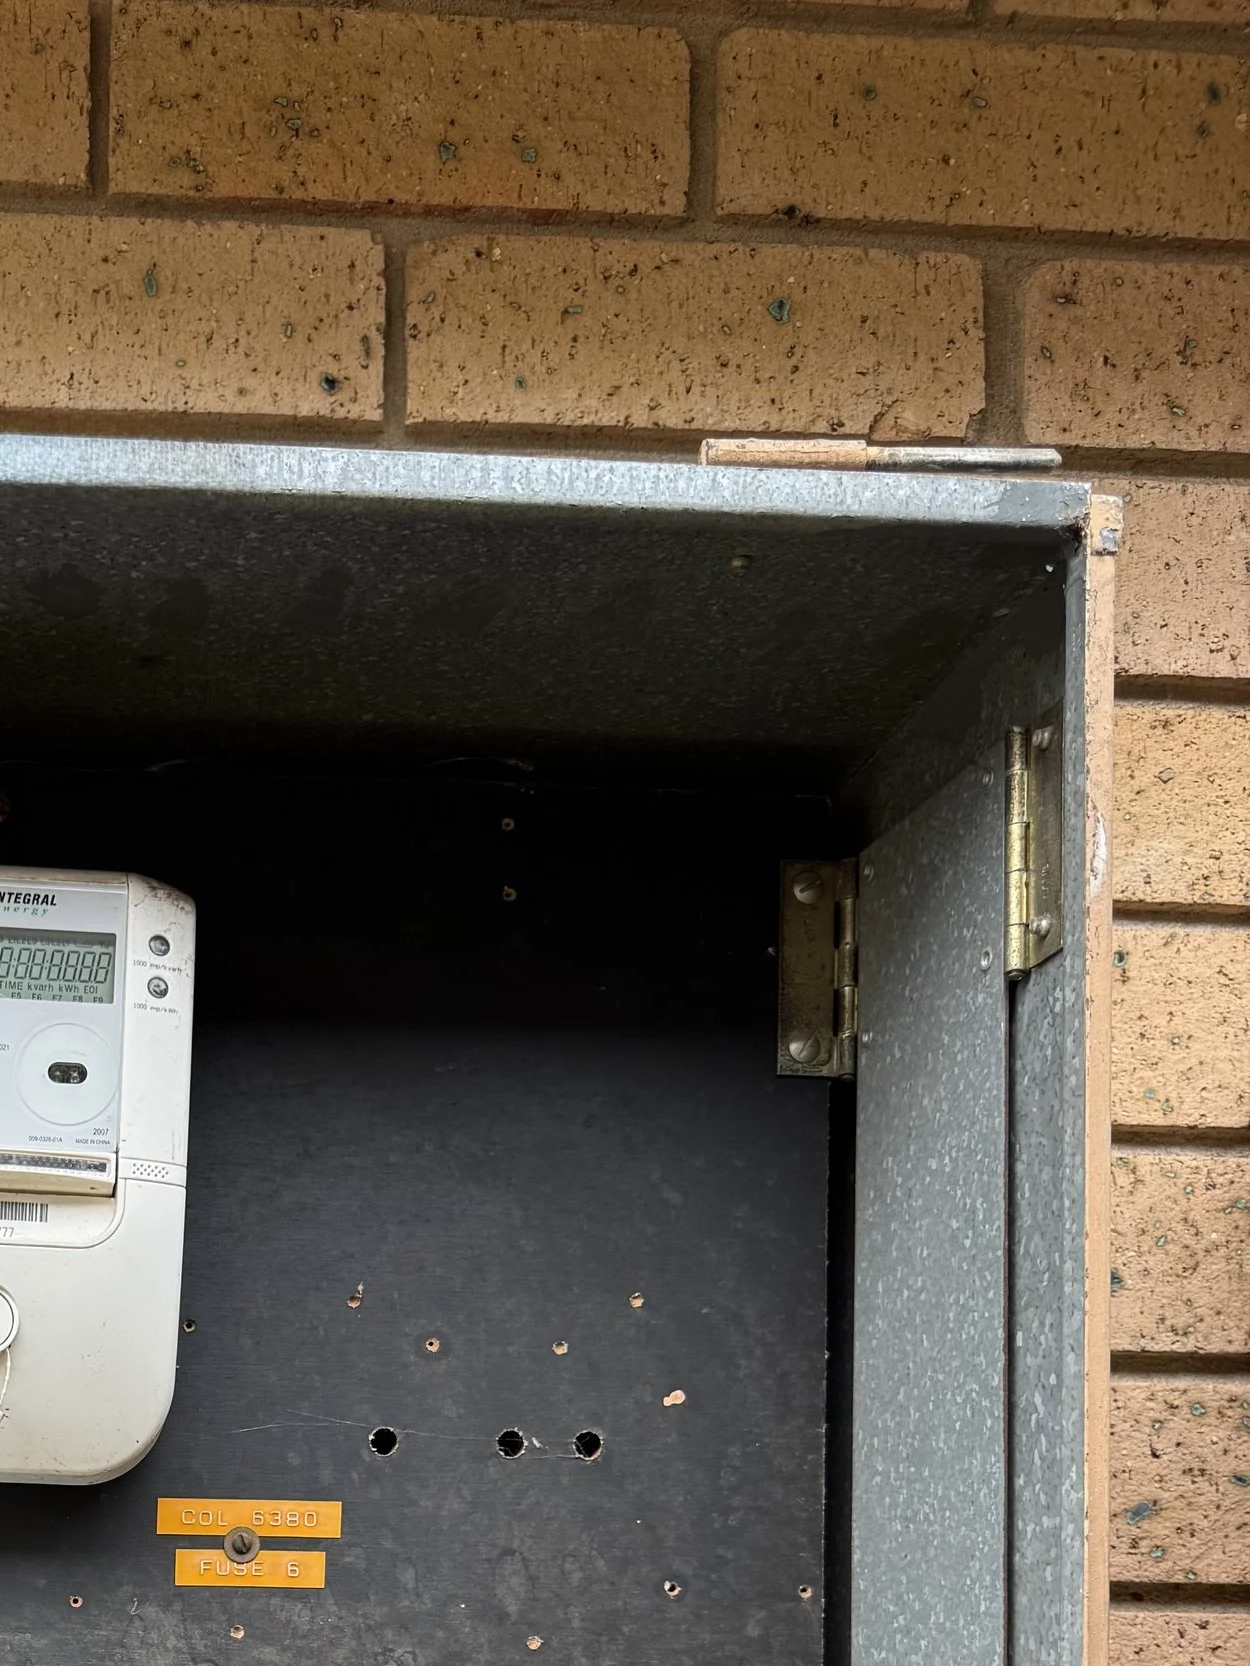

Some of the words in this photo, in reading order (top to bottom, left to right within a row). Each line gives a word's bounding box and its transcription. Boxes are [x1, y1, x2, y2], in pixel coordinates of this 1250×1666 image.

[58, 984, 79, 994] kWh
[93, 1128, 109, 1136] 2007
[181, 1509, 228, 1526] COL
[252, 1511, 317, 1527] 6380
[200, 1560, 264, 1576] FUSE
[287, 1562, 300, 1578] 6
